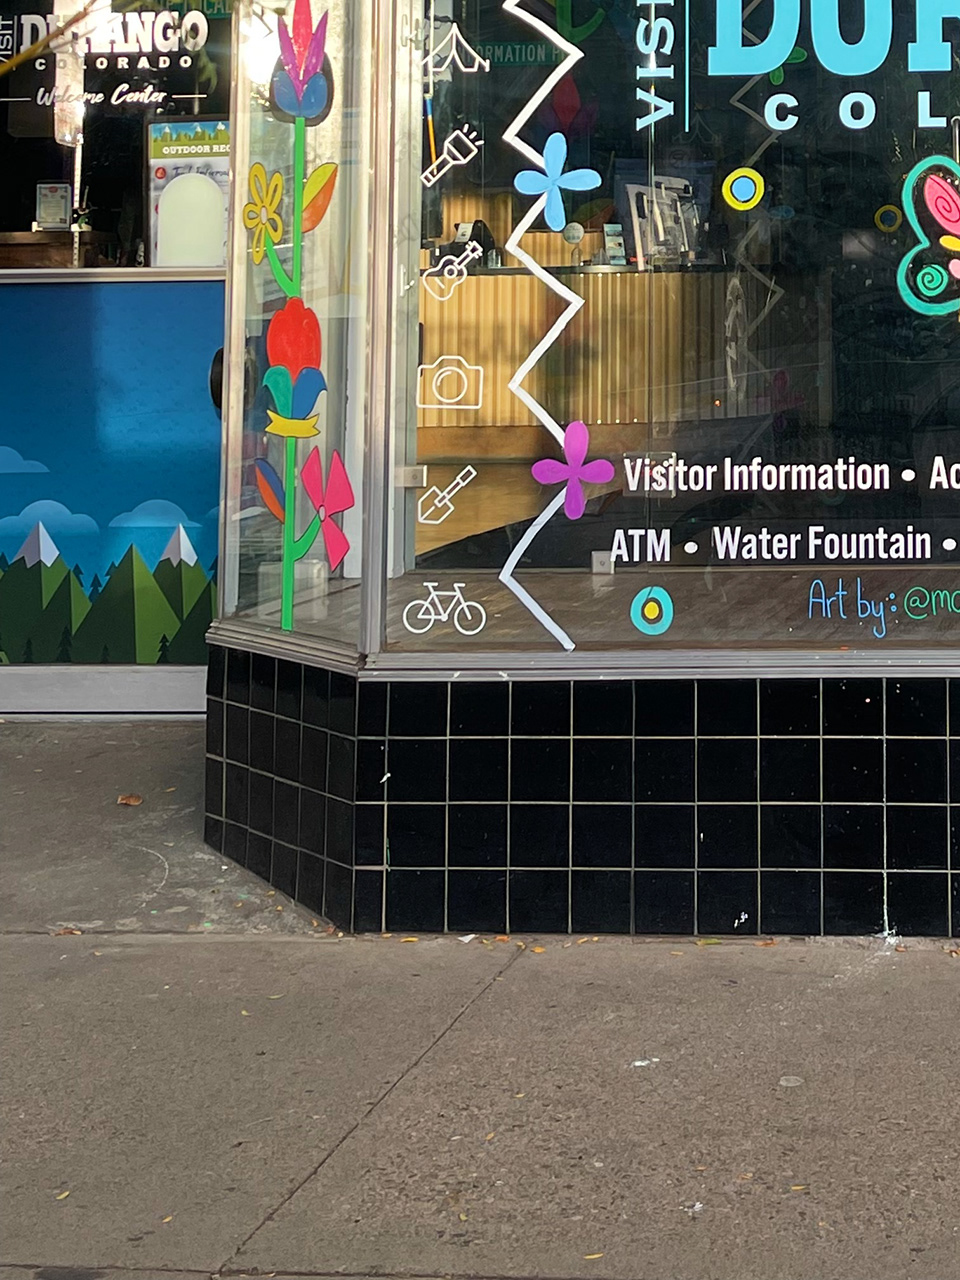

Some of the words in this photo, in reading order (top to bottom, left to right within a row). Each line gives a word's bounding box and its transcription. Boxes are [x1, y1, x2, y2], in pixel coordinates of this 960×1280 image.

[454, 44, 546, 65] NORMATION
[36, 85, 104, 106] Welcome
[110, 83, 168, 105] Center
[162, 145, 211, 155] OUTDOOR
[623, 457, 718, 492] Visitor
[723, 456, 891, 492] Information
[610, 528, 672, 563] ATM
[711, 525, 802, 561] Water
[807, 524, 932, 561] Fountain
[807, 577, 847, 619] Art
